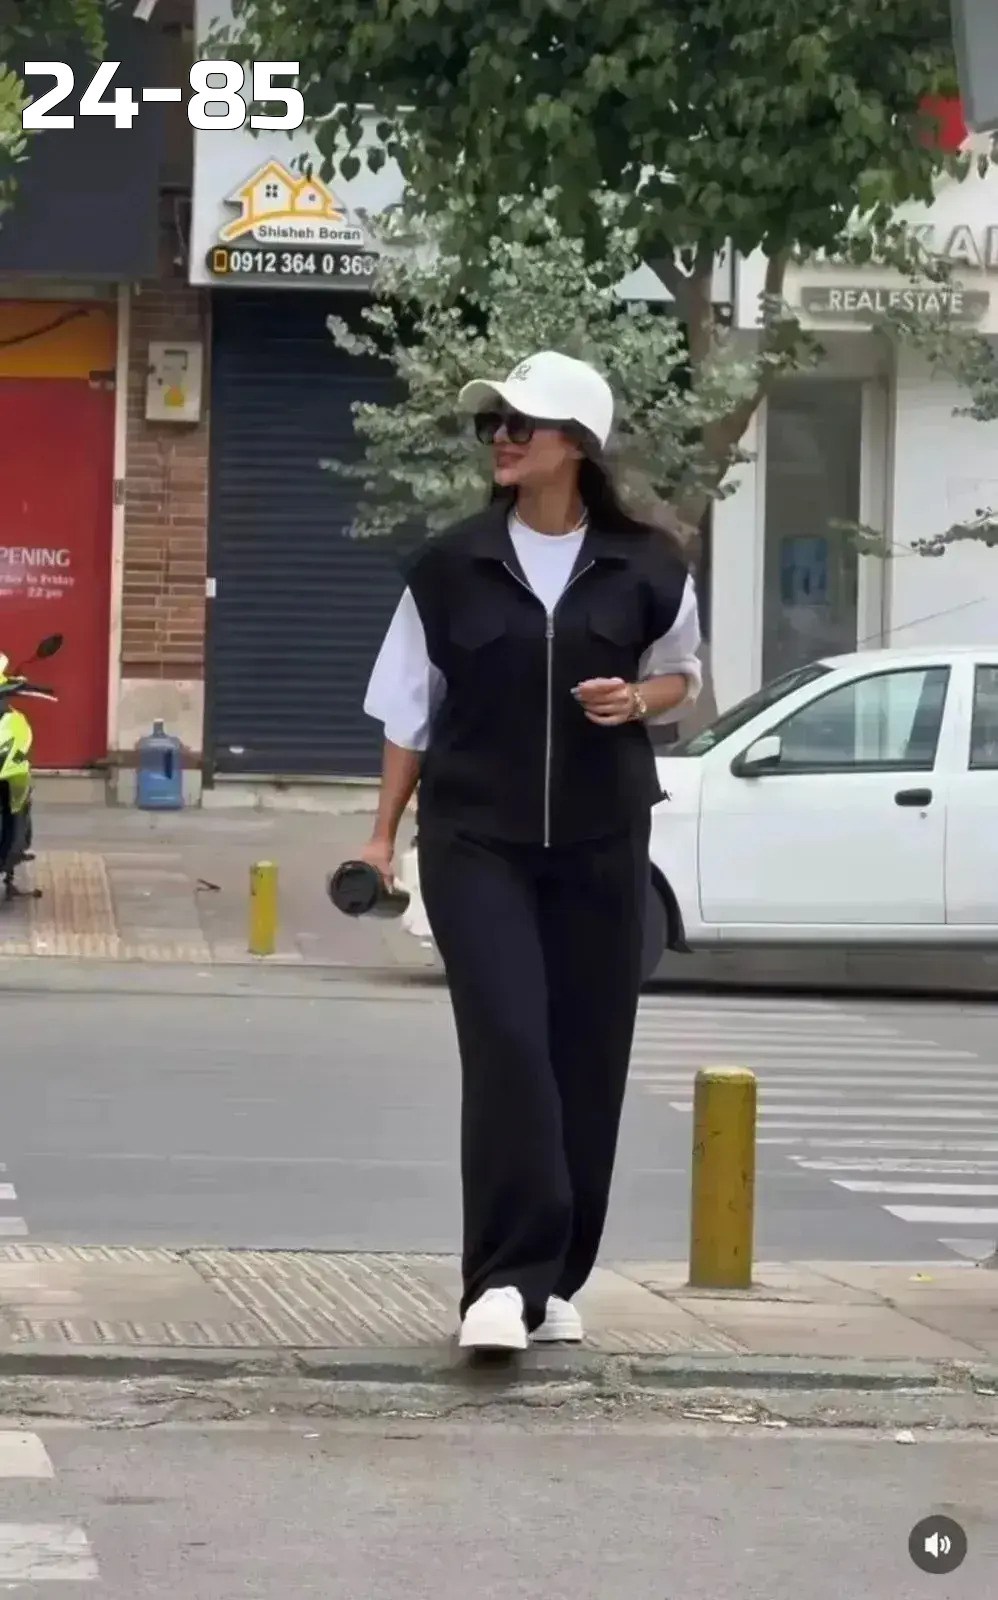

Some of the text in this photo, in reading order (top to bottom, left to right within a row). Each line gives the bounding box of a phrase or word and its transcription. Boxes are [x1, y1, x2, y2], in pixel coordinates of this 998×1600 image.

[258, 225, 361, 241] Shisheh Boran
[230, 251, 277, 273] 0912
[280, 252, 316, 273] 364
[322, 254, 334, 274] 0
[829, 290, 964, 315] REAL ESTATE
